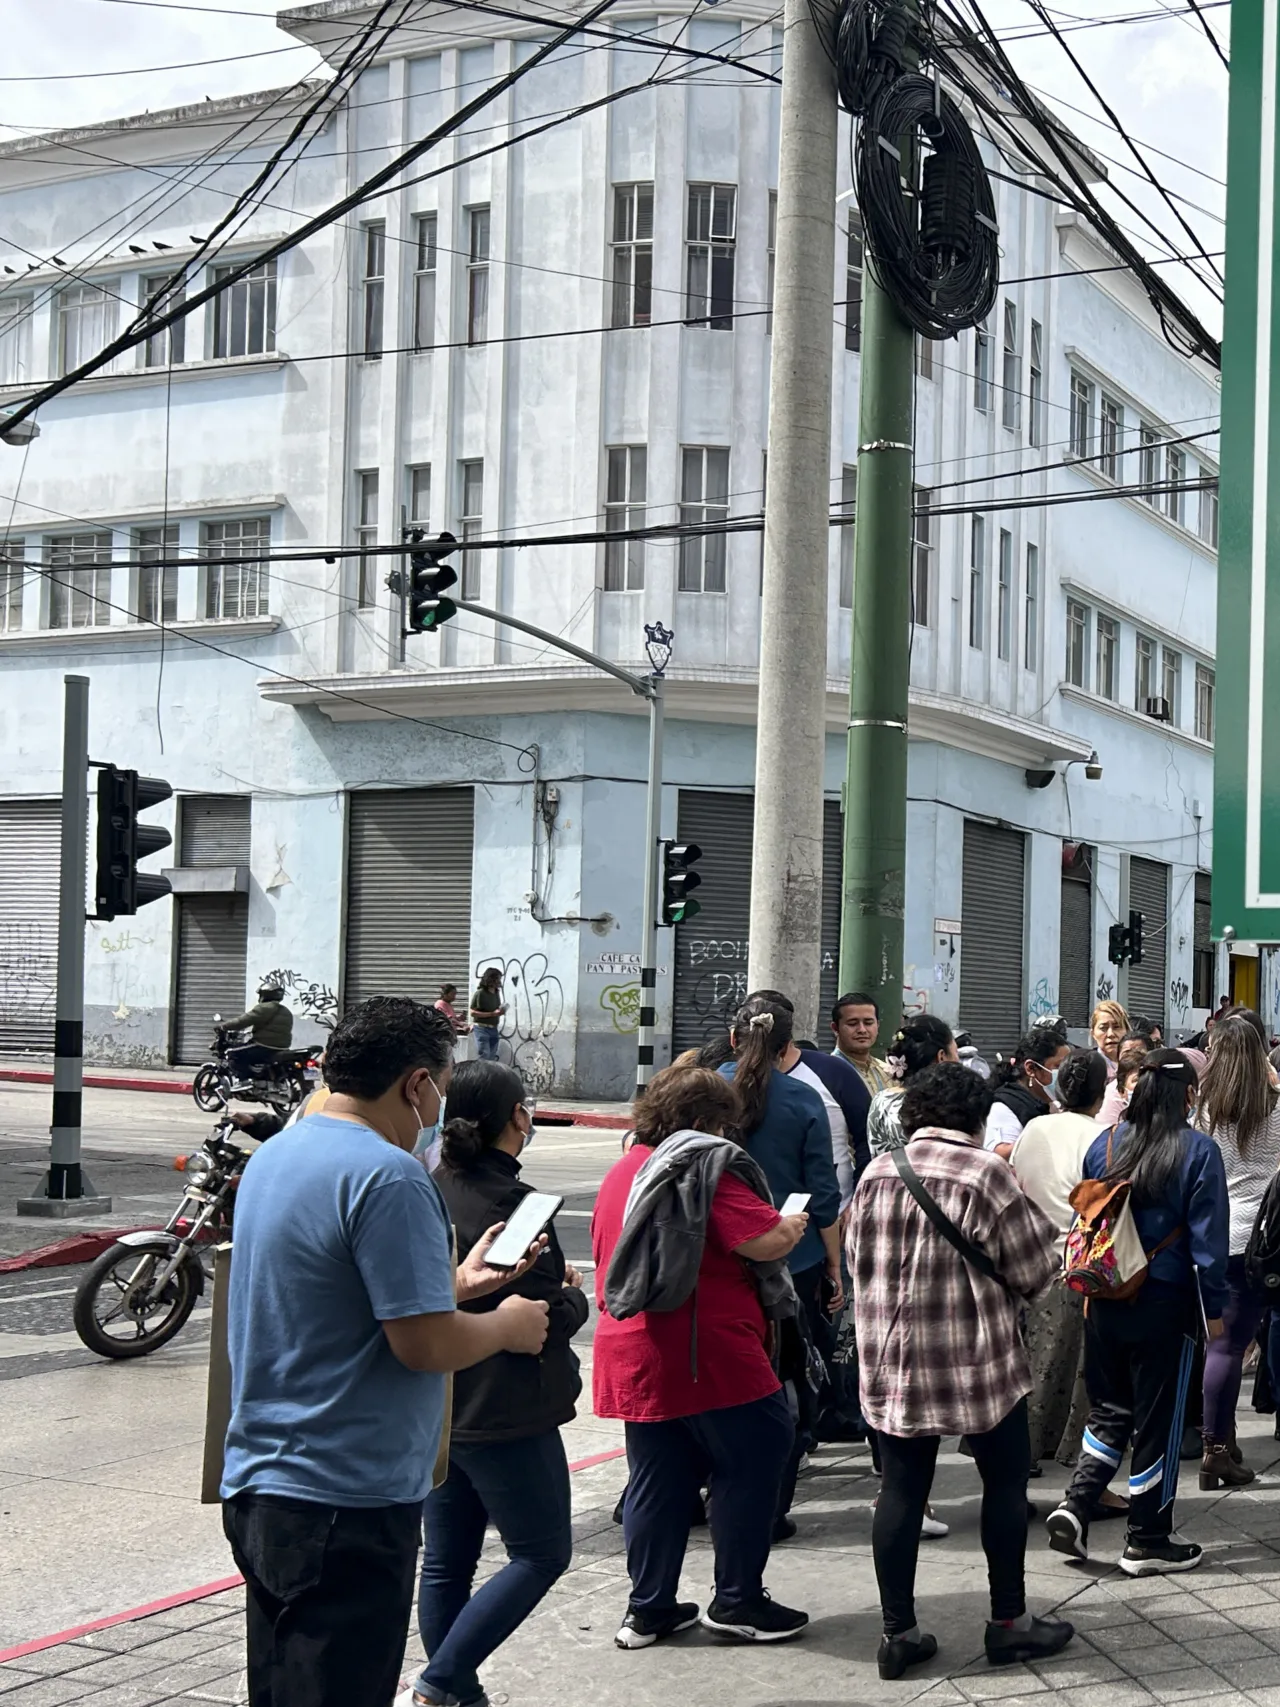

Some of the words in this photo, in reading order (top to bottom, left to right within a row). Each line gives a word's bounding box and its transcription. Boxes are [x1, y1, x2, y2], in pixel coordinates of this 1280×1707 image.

[601, 953, 624, 963] CAFE
[586, 963, 605, 973] PAN
[609, 964, 615, 973] Y
